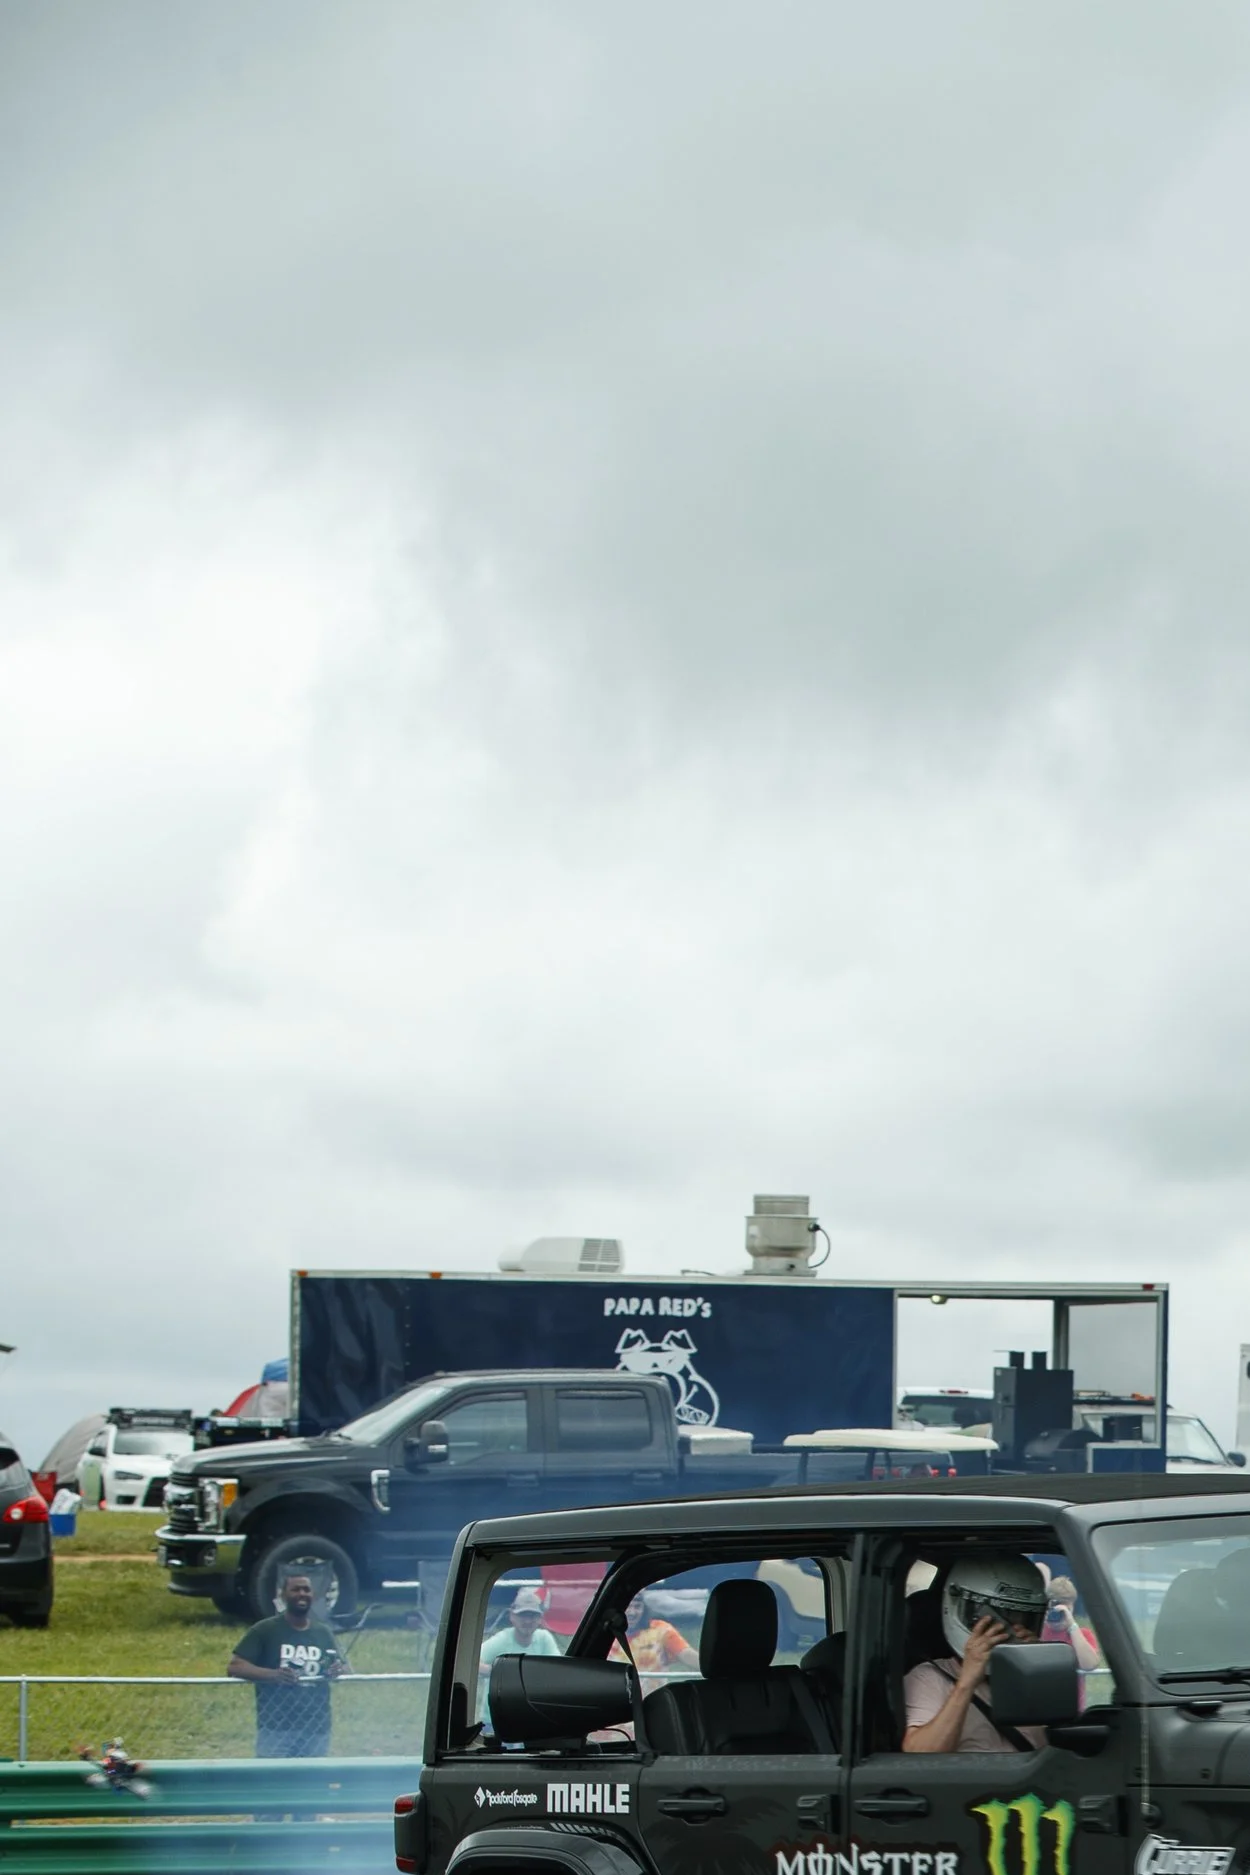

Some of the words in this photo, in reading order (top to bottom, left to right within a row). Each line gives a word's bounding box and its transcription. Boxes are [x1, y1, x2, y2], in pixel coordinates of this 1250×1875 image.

[603, 1297, 655, 1317] PAPA
[280, 1644, 321, 1660] DAD
[547, 1783, 630, 1813] MAHLE
